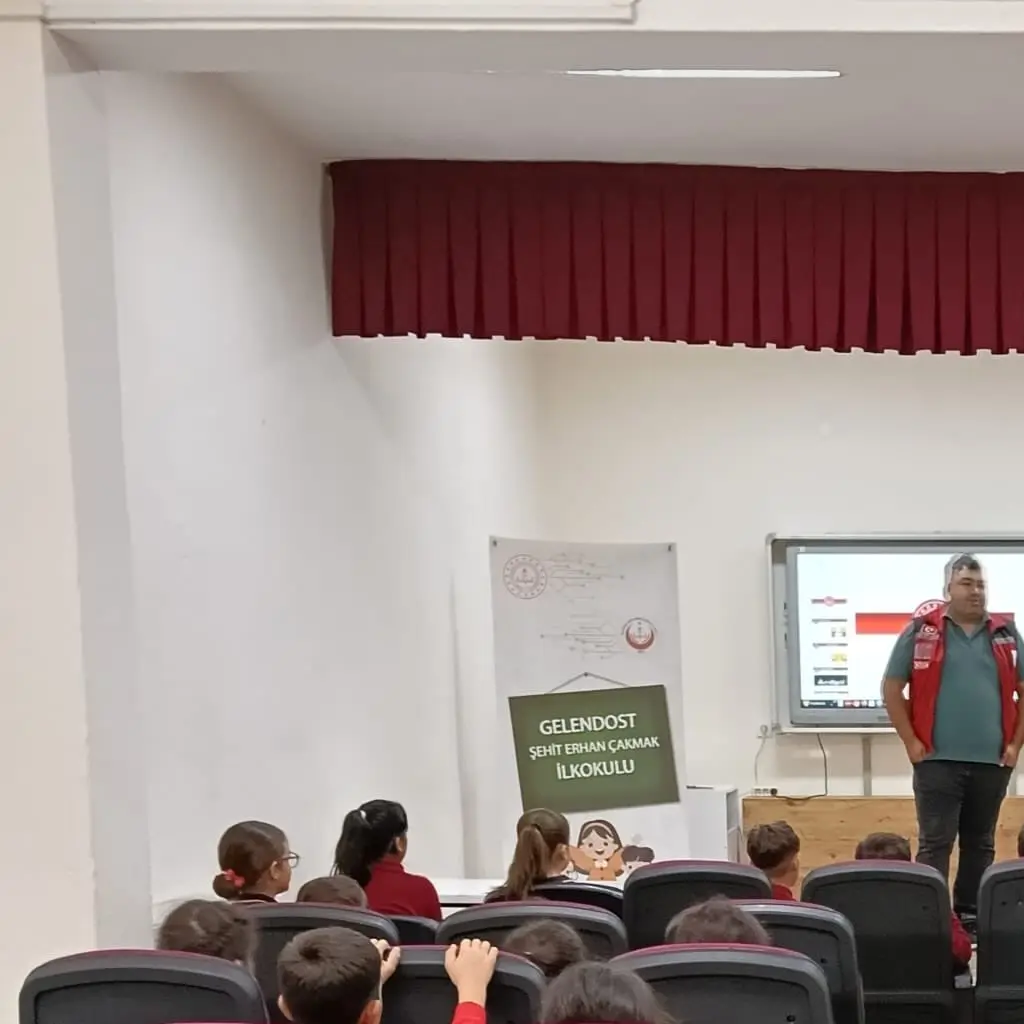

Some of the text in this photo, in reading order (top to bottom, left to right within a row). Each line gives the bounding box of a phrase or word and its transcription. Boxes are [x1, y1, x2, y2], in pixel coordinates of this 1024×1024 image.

[539, 713, 637, 735] GELENDOST
[529, 736, 660, 760] ŞEHİT ERHAN ÇAKMAK
[556, 759, 635, 780] İLKOKULU
